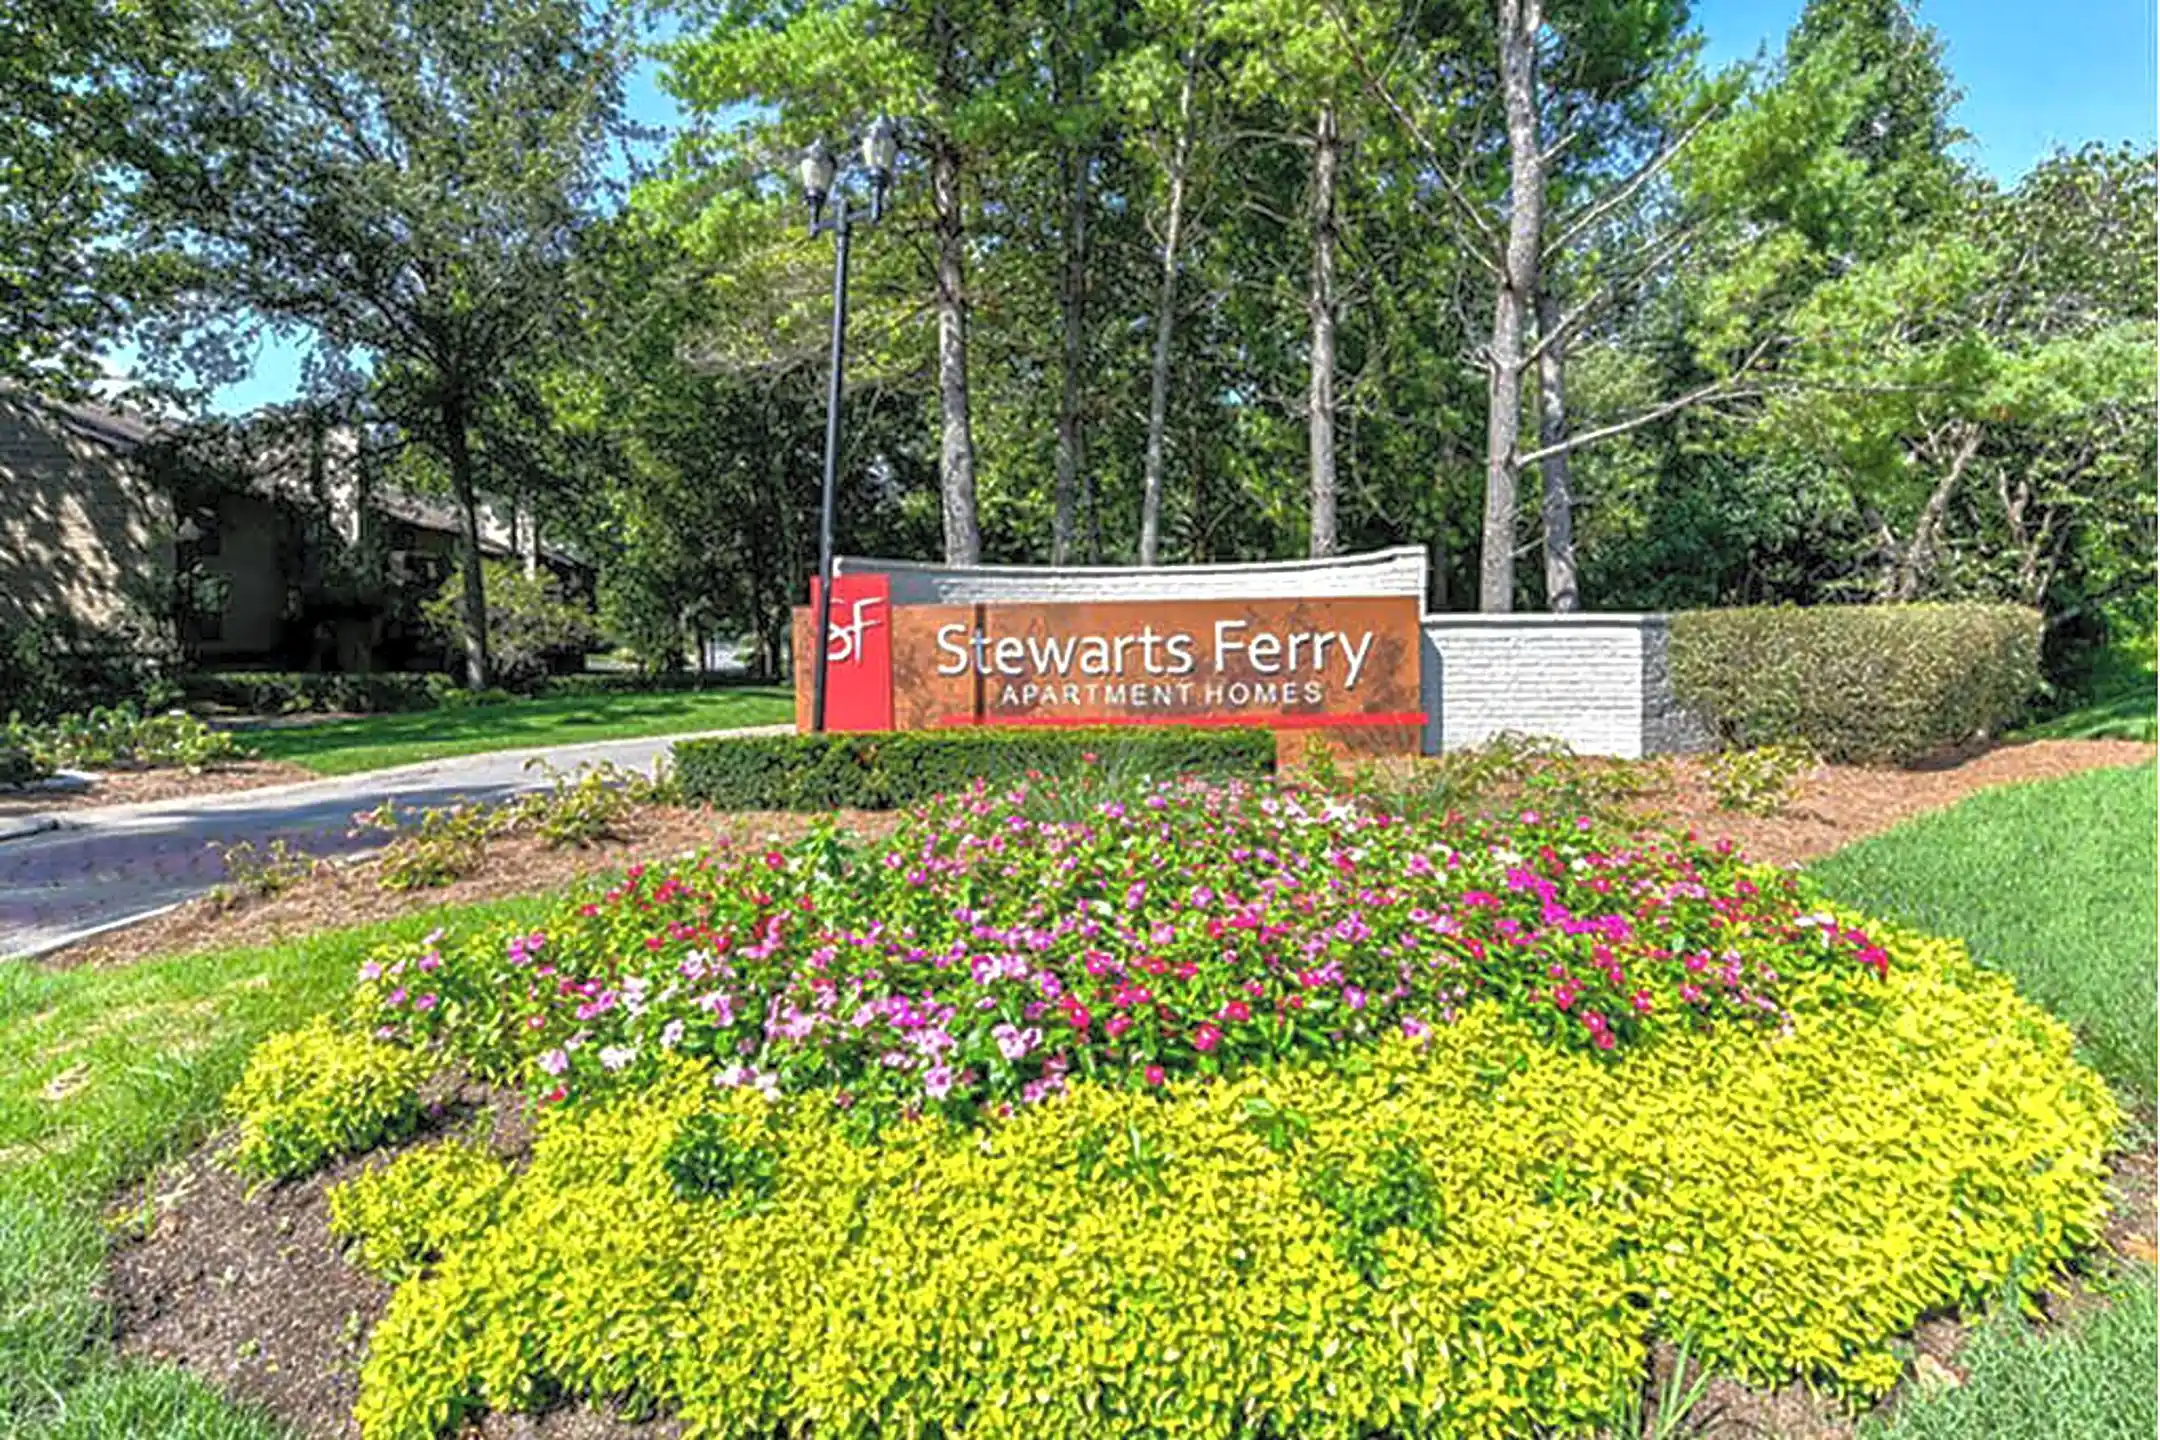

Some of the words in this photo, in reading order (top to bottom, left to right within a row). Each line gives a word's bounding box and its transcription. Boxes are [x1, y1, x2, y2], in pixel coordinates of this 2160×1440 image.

[937, 623, 1192, 675] Stewarts
[1214, 620, 1372, 688] Ferry
[1002, 683, 1193, 706] APARTMENT
[1206, 682, 1322, 705] HOMES
